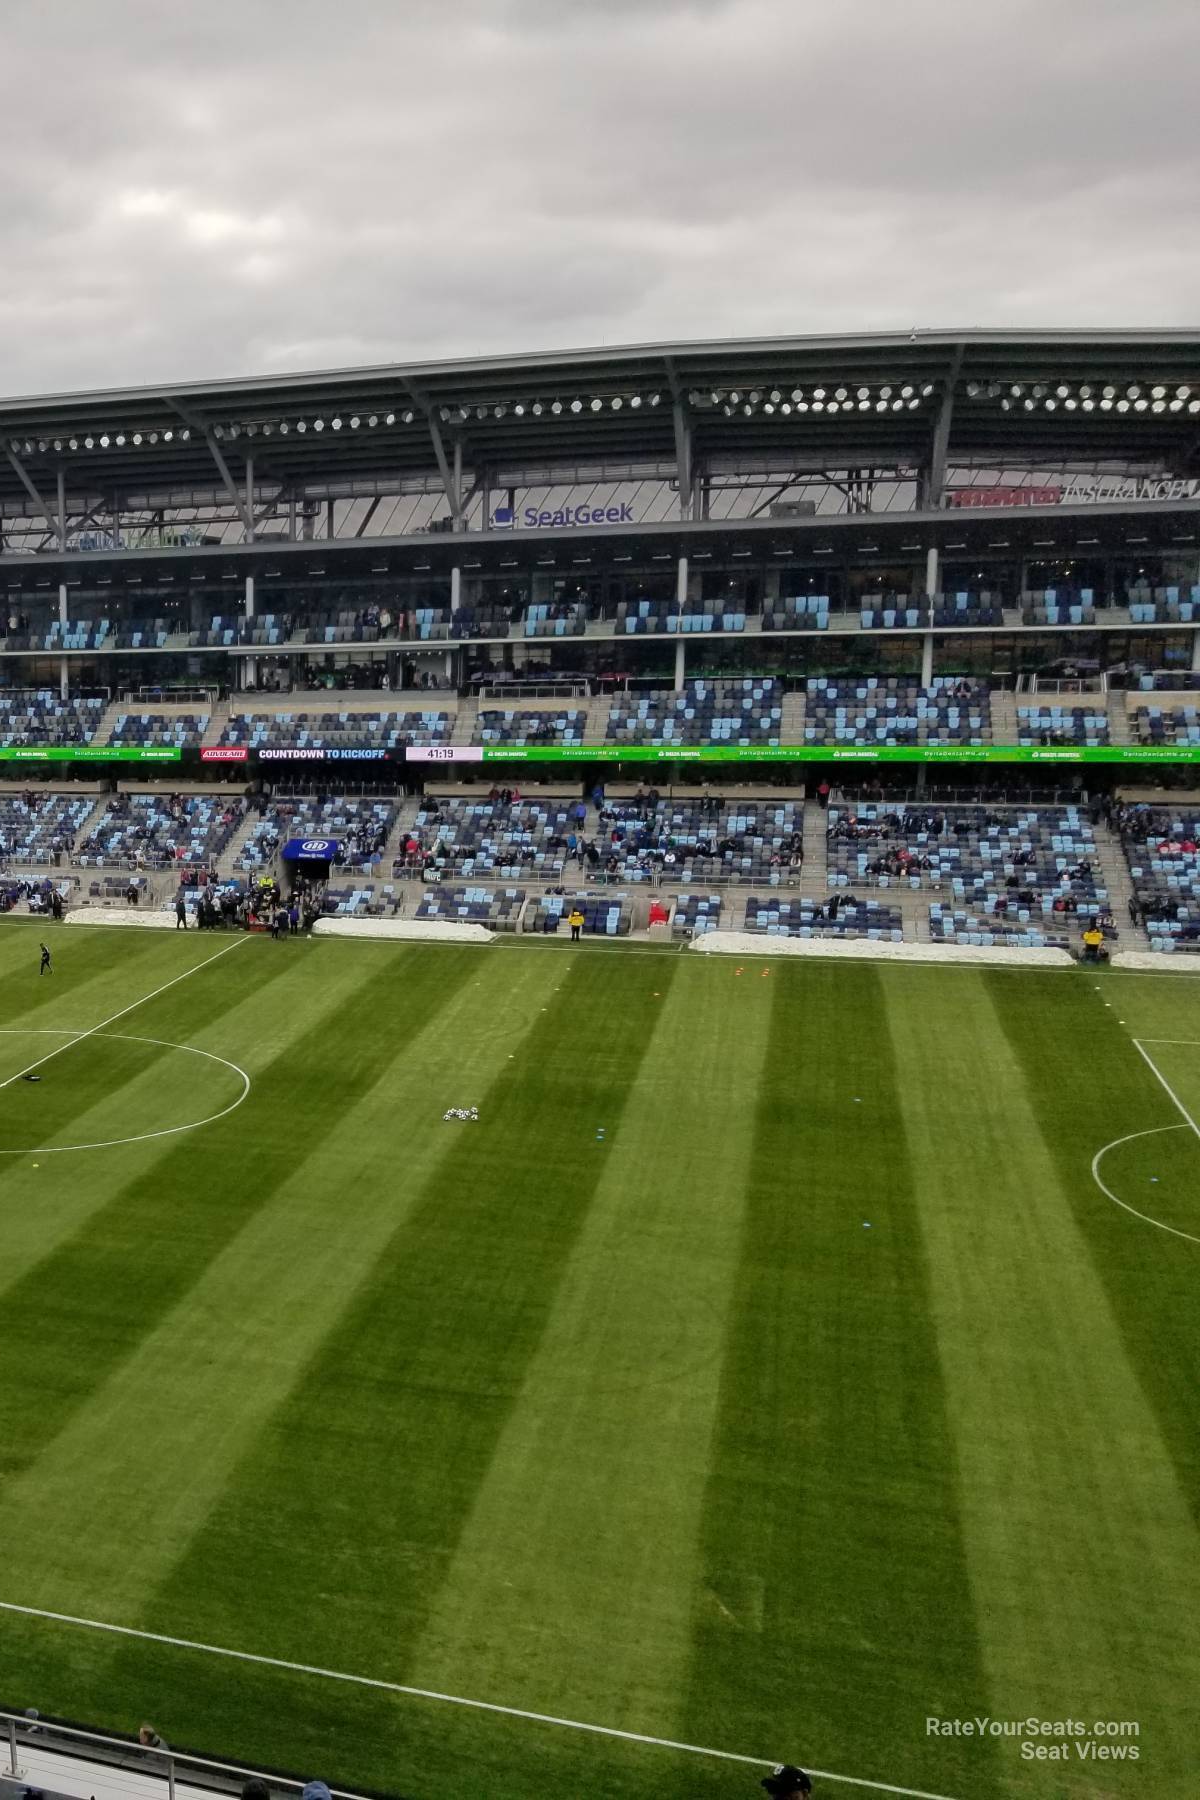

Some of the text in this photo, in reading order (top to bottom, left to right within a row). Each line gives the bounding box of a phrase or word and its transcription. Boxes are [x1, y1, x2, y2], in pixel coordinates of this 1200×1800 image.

[524, 502, 634, 528] SeatGeek
[259, 749, 324, 759] COUNTDOWN
[325, 749, 339, 759] TO
[427, 748, 454, 759] 41:19
